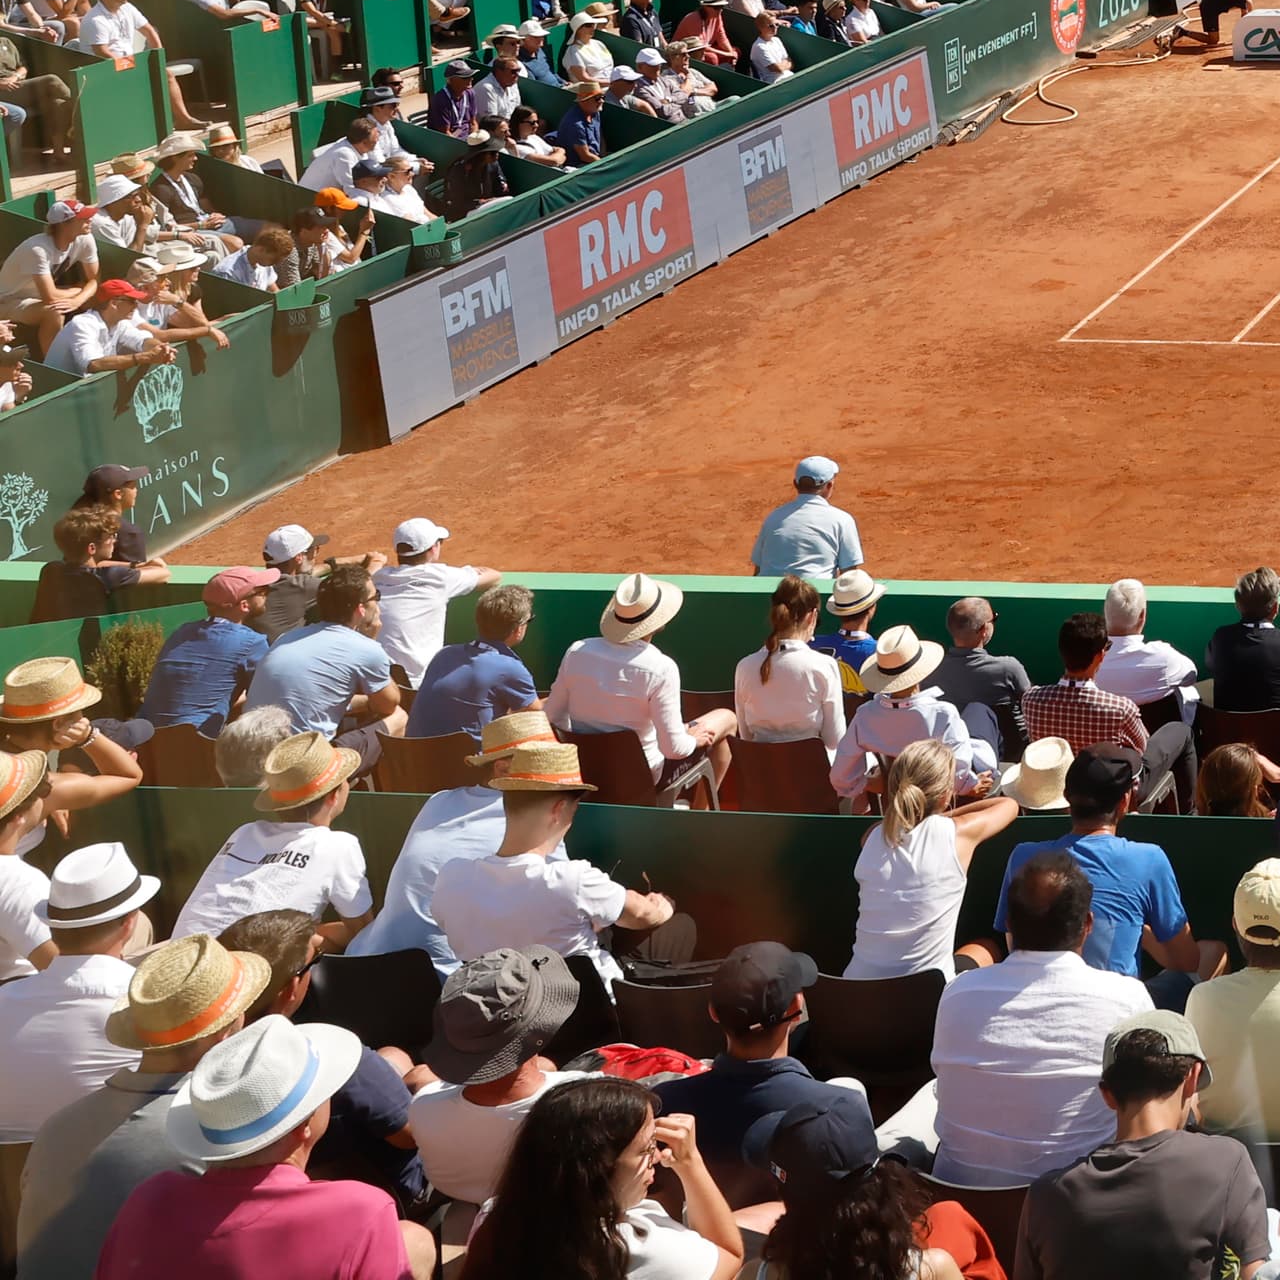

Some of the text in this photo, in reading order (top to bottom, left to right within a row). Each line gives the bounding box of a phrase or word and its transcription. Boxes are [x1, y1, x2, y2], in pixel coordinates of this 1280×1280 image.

[853, 75, 912, 150] RMC
[740, 133, 787, 187] BFM
[841, 126, 931, 187] INFO TALK SPORT
[577, 189, 666, 289] RMC
[441, 269, 512, 340] BFM
[559, 251, 695, 337] INFO TALK SPORT
[449, 316, 513, 363] MARSEILLE
[451, 340, 518, 384] PROVENCE
[139, 449, 201, 490] maison
